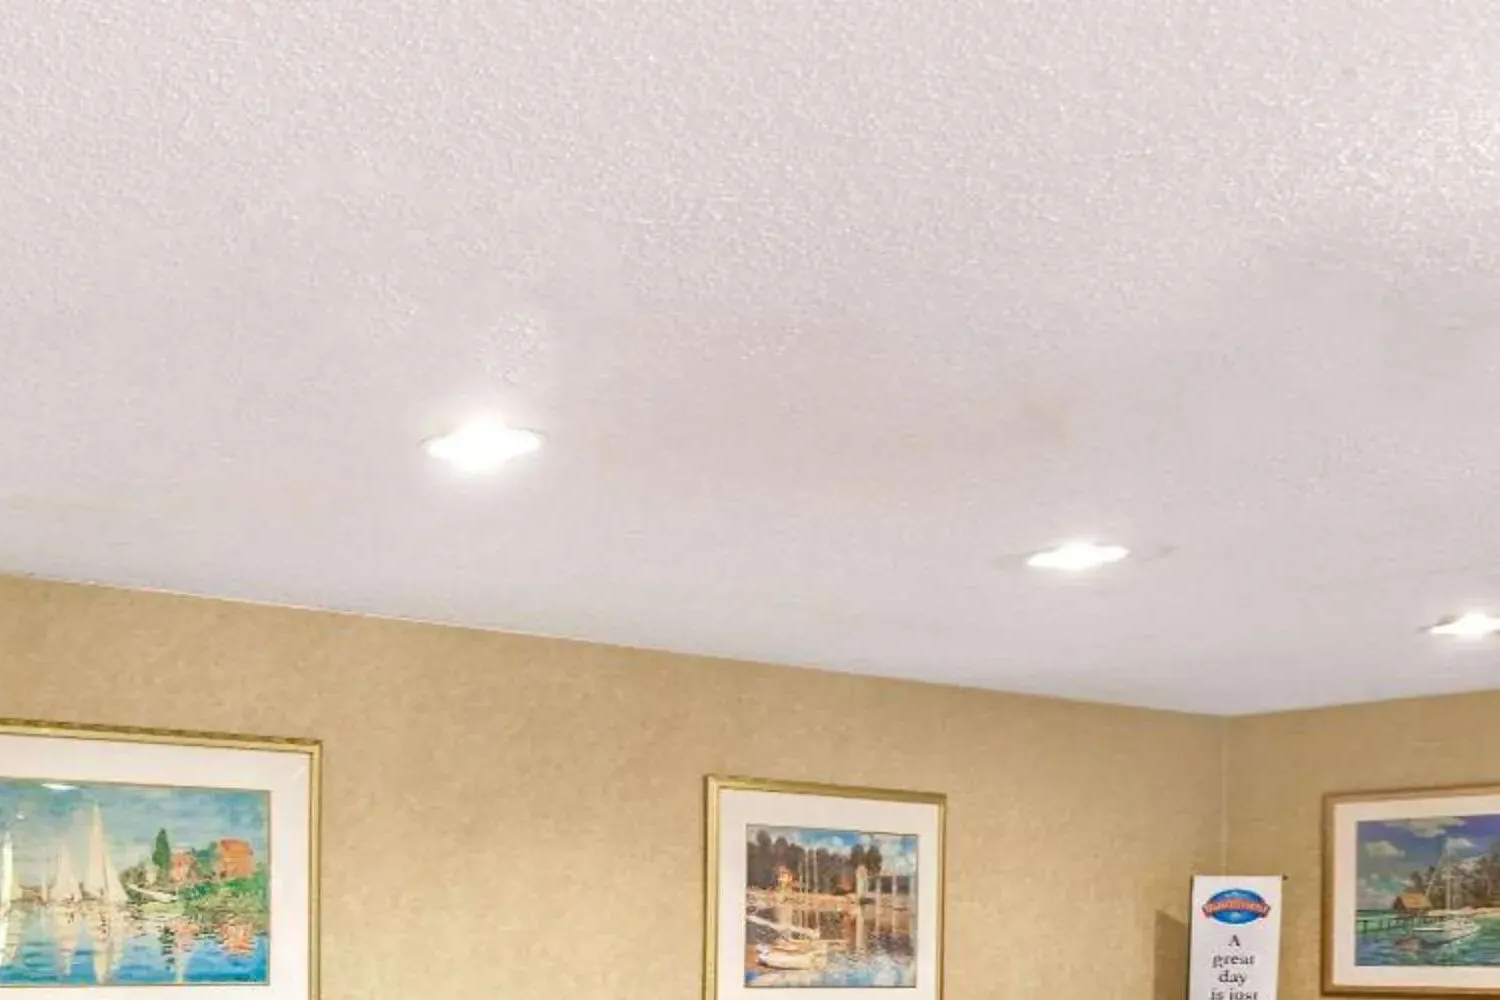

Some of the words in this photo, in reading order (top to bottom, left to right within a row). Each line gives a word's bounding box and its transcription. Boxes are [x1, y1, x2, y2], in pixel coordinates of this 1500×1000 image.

[1227, 933, 1241, 947] A
[1211, 954, 1256, 969] great
[1217, 969, 1247, 987] day
[1210, 988, 1225, 1000] is
